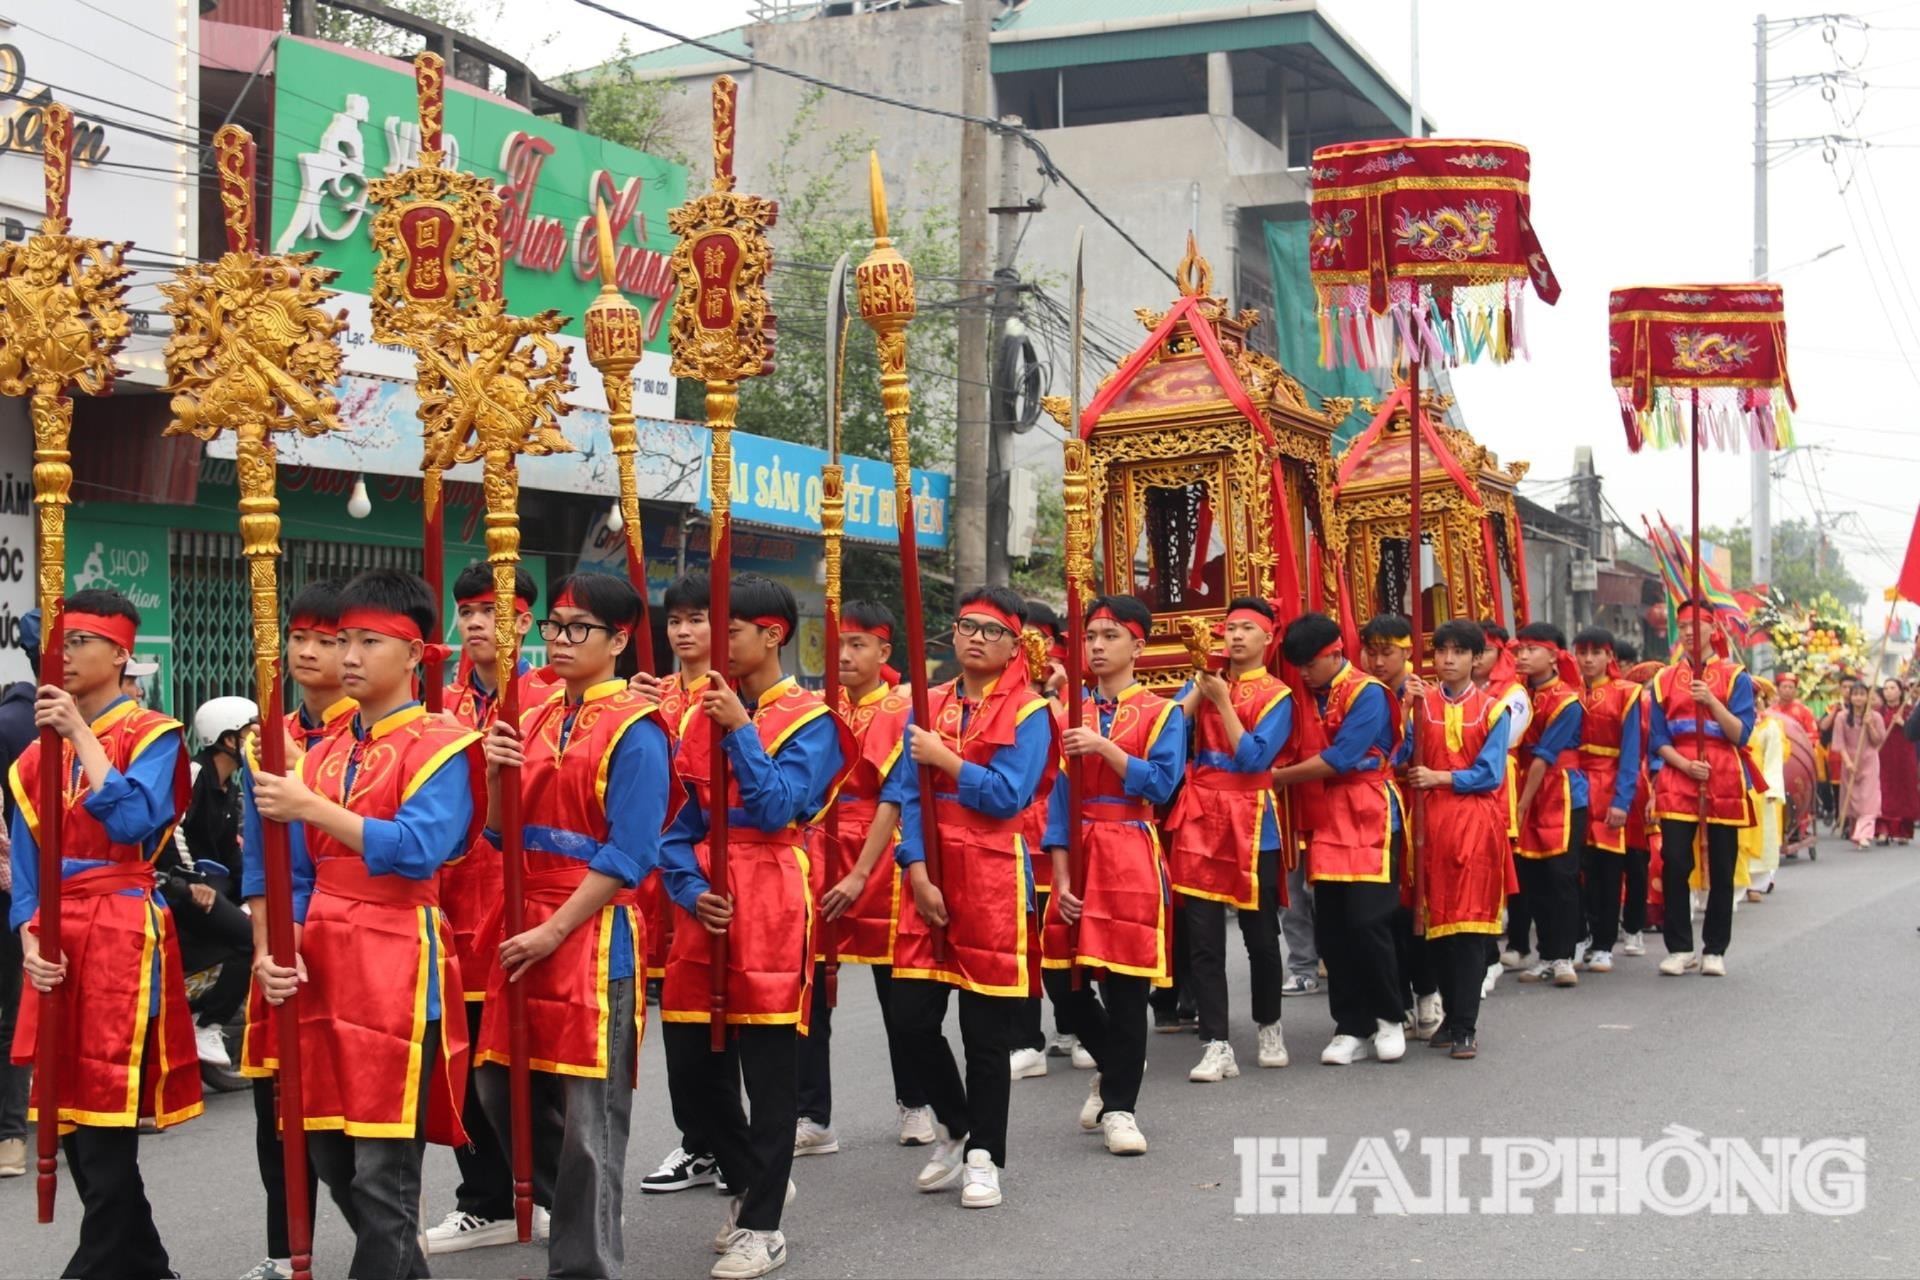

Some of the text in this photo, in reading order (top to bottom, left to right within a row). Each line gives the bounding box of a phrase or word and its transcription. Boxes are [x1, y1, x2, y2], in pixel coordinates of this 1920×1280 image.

[383, 115, 460, 175] SHP
[0, 472, 29, 516] ĂM
[754, 455, 800, 512] SẢN
[805, 463, 875, 524] QẾT
[877, 476, 944, 535] HỀN
[109, 548, 149, 578] SHOP
